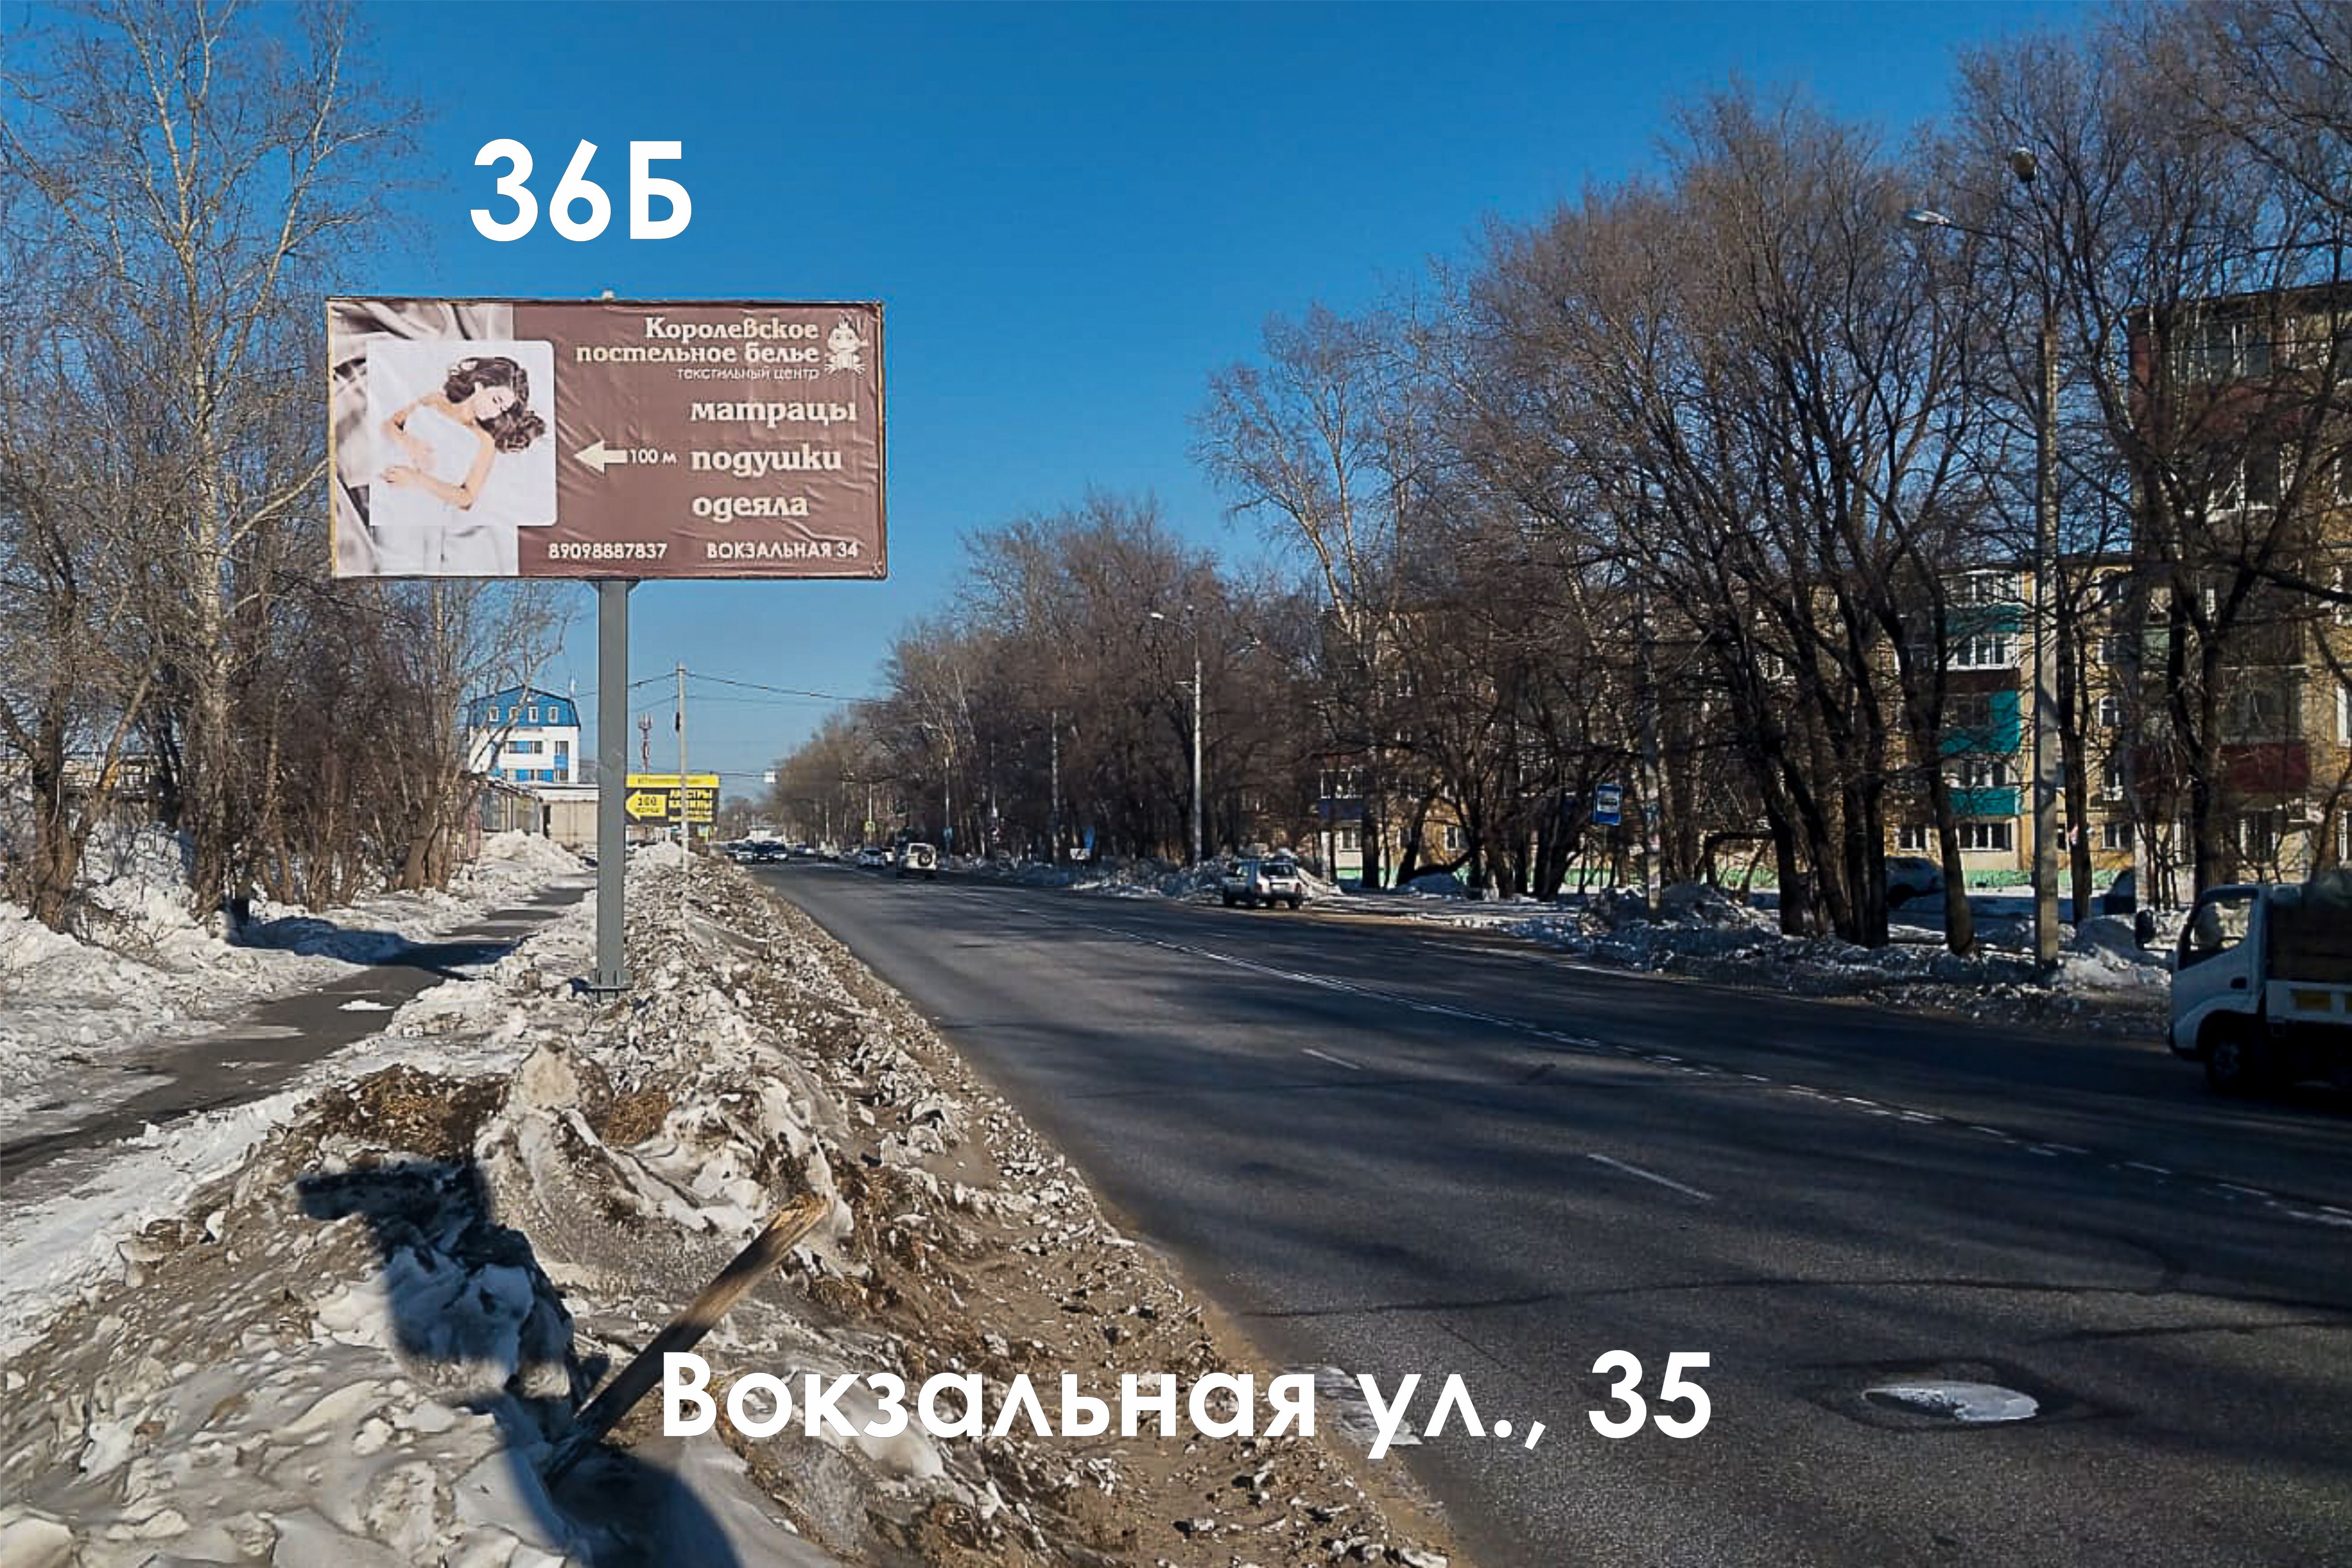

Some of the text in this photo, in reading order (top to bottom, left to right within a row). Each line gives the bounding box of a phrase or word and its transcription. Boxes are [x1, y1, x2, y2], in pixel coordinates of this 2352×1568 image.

[645, 317, 820, 343] Королевское
[576, 343, 820, 363] постельное белье
[677, 367, 820, 381] текстильный центр
[690, 402, 858, 428] матрацы
[630, 448, 677, 464] 100 м
[691, 445, 842, 477] подушки
[692, 497, 810, 522] одеяла
[548, 543, 668, 560] 89098887837
[707, 542, 858, 559] ВОКЗАЛЬНАЯ 34
